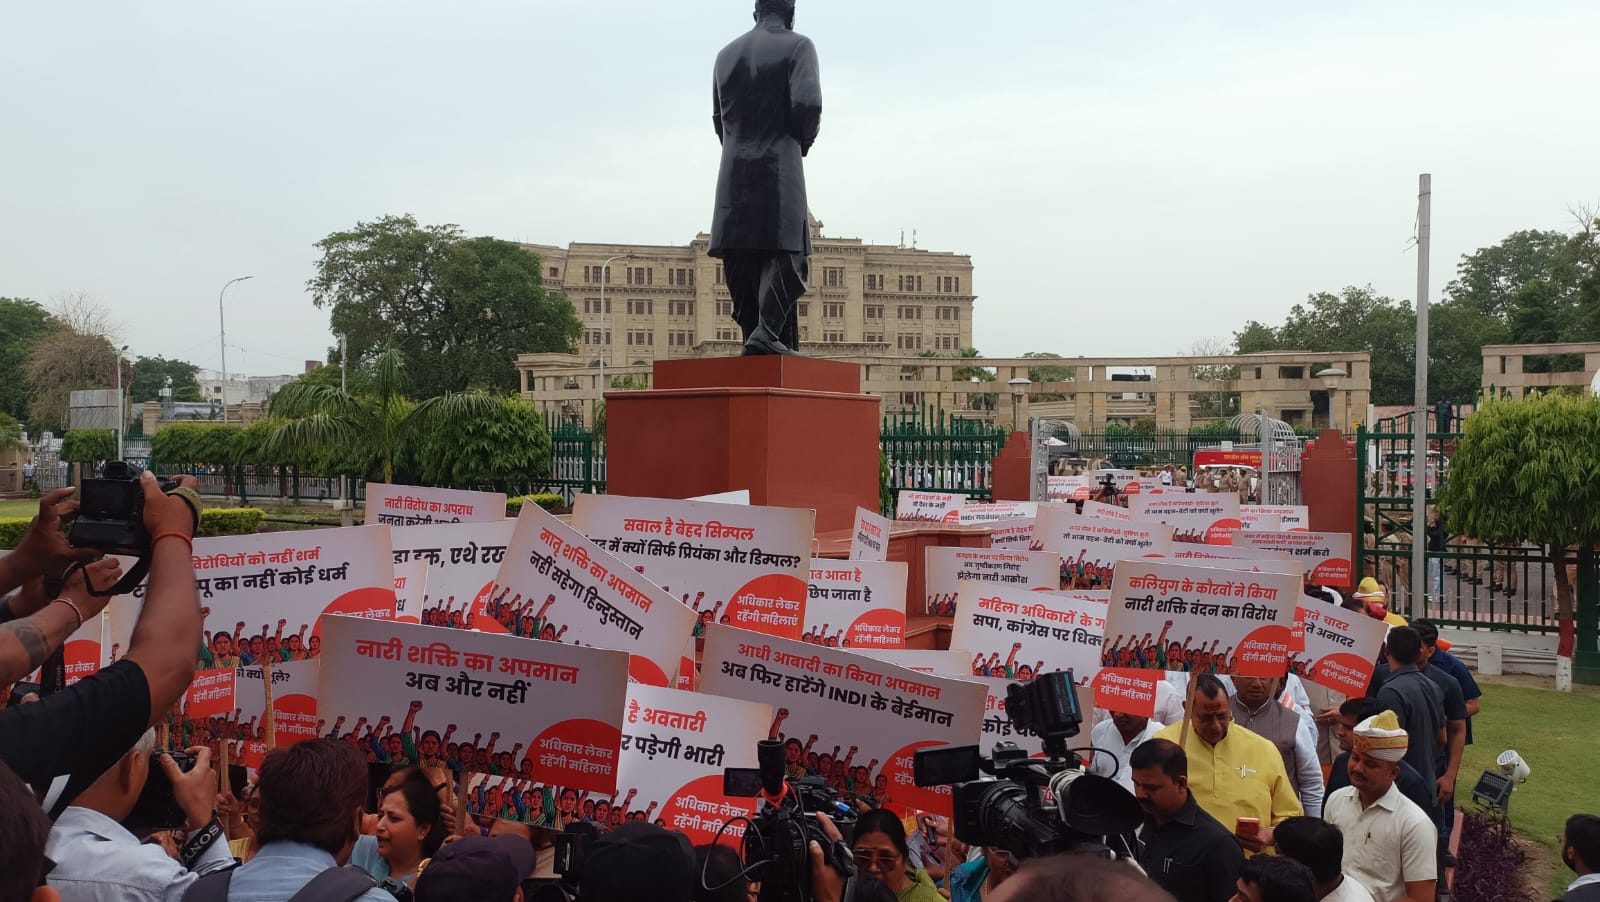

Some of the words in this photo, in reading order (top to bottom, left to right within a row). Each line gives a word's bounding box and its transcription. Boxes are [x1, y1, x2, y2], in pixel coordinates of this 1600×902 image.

[384, 496, 402, 509] नारी
[404, 496, 428, 512] विरोध
[429, 502, 442, 513] का
[443, 504, 473, 516] अपराध
[378, 514, 404, 526] जनता
[624, 518, 662, 533] सवाल
[665, 516, 673, 535] है
[676, 518, 703, 537] बेहद
[706, 520, 755, 540] सिम्पल
[248, 551, 266, 565] को
[269, 548, 294, 564] नहीं
[296, 546, 321, 561] शर्म
[450, 542, 478, 565] एथे
[609, 537, 622, 552] में
[622, 539, 647, 555] क्यों
[648, 540, 676, 557] सिर्फ
[678, 542, 721, 562] प्रियंका
[723, 546, 747, 564] और
[750, 548, 801, 568] डिम्पल?
[1295, 547, 1312, 556] शर्म
[1313, 548, 1330, 556] करो
[214, 576, 238, 591] का
[242, 568, 278, 589] नहीं
[278, 565, 316, 585] कोई
[318, 562, 350, 582] धर्म
[539, 527, 563, 557] मातृ
[563, 543, 591, 570] शक्ति
[589, 565, 608, 582] का
[607, 575, 653, 614] अपमान
[825, 570, 852, 580] आता
[854, 568, 862, 582] है
[957, 570, 981, 580] झेलेगा
[982, 571, 999, 581] नारी
[1000, 573, 1028, 584] आक्रोश
[530, 550, 556, 576] नहीं
[551, 566, 585, 598] सहेगा
[584, 586, 644, 640] हिन्दुस्तान
[831, 589, 861, 600] जाता
[864, 586, 872, 602] है
[1129, 574, 1180, 596] कलियुग
[1182, 578, 1194, 593] के
[1196, 578, 1233, 597] कौरवों
[1234, 583, 1245, 598] ने
[1247, 583, 1277, 600] किया
[737, 594, 774, 607] अधिकार
[775, 597, 800, 610] लेकर
[978, 597, 1019, 614] महिला
[1022, 603, 1077, 624] अधिकारों
[1080, 613, 1092, 627] के
[1125, 595, 1154, 612] नारी
[1156, 597, 1187, 614] शक्ति
[1190, 600, 1220, 617] वंदन
[1222, 605, 1240, 618] का
[1242, 604, 1277, 621] विरोध
[737, 609, 759, 622] रहेंगी
[761, 612, 798, 626] महिलाएं
[1324, 615, 1350, 631] चादर
[854, 623, 881, 632] अधिकार
[882, 624, 901, 633] लेकर
[973, 614, 1002, 631] सपा,
[1006, 618, 1050, 638] कांग्रेस
[1052, 629, 1070, 642] पर
[1317, 628, 1355, 647] अनादर
[854, 635, 871, 643] रहेंगी
[872, 635, 900, 644] महिलाएं
[1243, 640, 1270, 651] अधिकार
[1271, 643, 1287, 653] लेकर
[75, 661, 95, 672] लेकर
[356, 637, 403, 661] नारी
[407, 642, 460, 668] शक्ति
[463, 652, 494, 672] का
[498, 658, 579, 684] अपमान
[1242, 653, 1259, 662] रहेंगी
[1260, 653, 1285, 663] महिलाएं
[216, 672, 232, 682] लेकर
[738, 643, 771, 661] आधी
[823, 662, 843, 677] का
[845, 664, 882, 686] किया
[885, 676, 941, 700] अपमान
[1322, 668, 1337, 679] रहेंगी
[1338, 674, 1364, 688] महिलाएं
[1323, 660, 1348, 674] अधिकार
[1350, 669, 1367, 680] लेकर
[405, 671, 440, 692] अब
[445, 673, 483, 698] और
[487, 679, 532, 704] नहीं
[1101, 673, 1131, 686] अधिकार
[1132, 679, 1153, 690] लेकर
[194, 692, 208, 703] रहेंगी
[208, 687, 232, 699] महिलाएं
[721, 661, 747, 679] अब
[750, 662, 782, 687] फिर
[785, 674, 826, 698] हारेंगे
[828, 686, 867, 707] INDI
[870, 692, 889, 711] के
[891, 696, 954, 727] बेईमान
[1101, 685, 1119, 696] रहेंगी
[1121, 688, 1152, 701] महिलाएं
[297, 712, 316, 723] लेकर
[628, 699, 640, 724] है
[643, 708, 707, 733] अवतारी
[288, 724, 316, 735] महिलाएं
[982, 716, 1012, 737] कोई
[539, 736, 583, 755] अधिकार
[585, 743, 613, 760] लेकर
[636, 734, 681, 760] पड़ेगी
[684, 744, 725, 766] भारी
[540, 754, 567, 771] रहेंगी
[569, 757, 612, 776] महिलाएं
[676, 796, 718, 814] अधिकार
[720, 802, 749, 817] लेकर
[674, 814, 700, 830] रहेंगी
